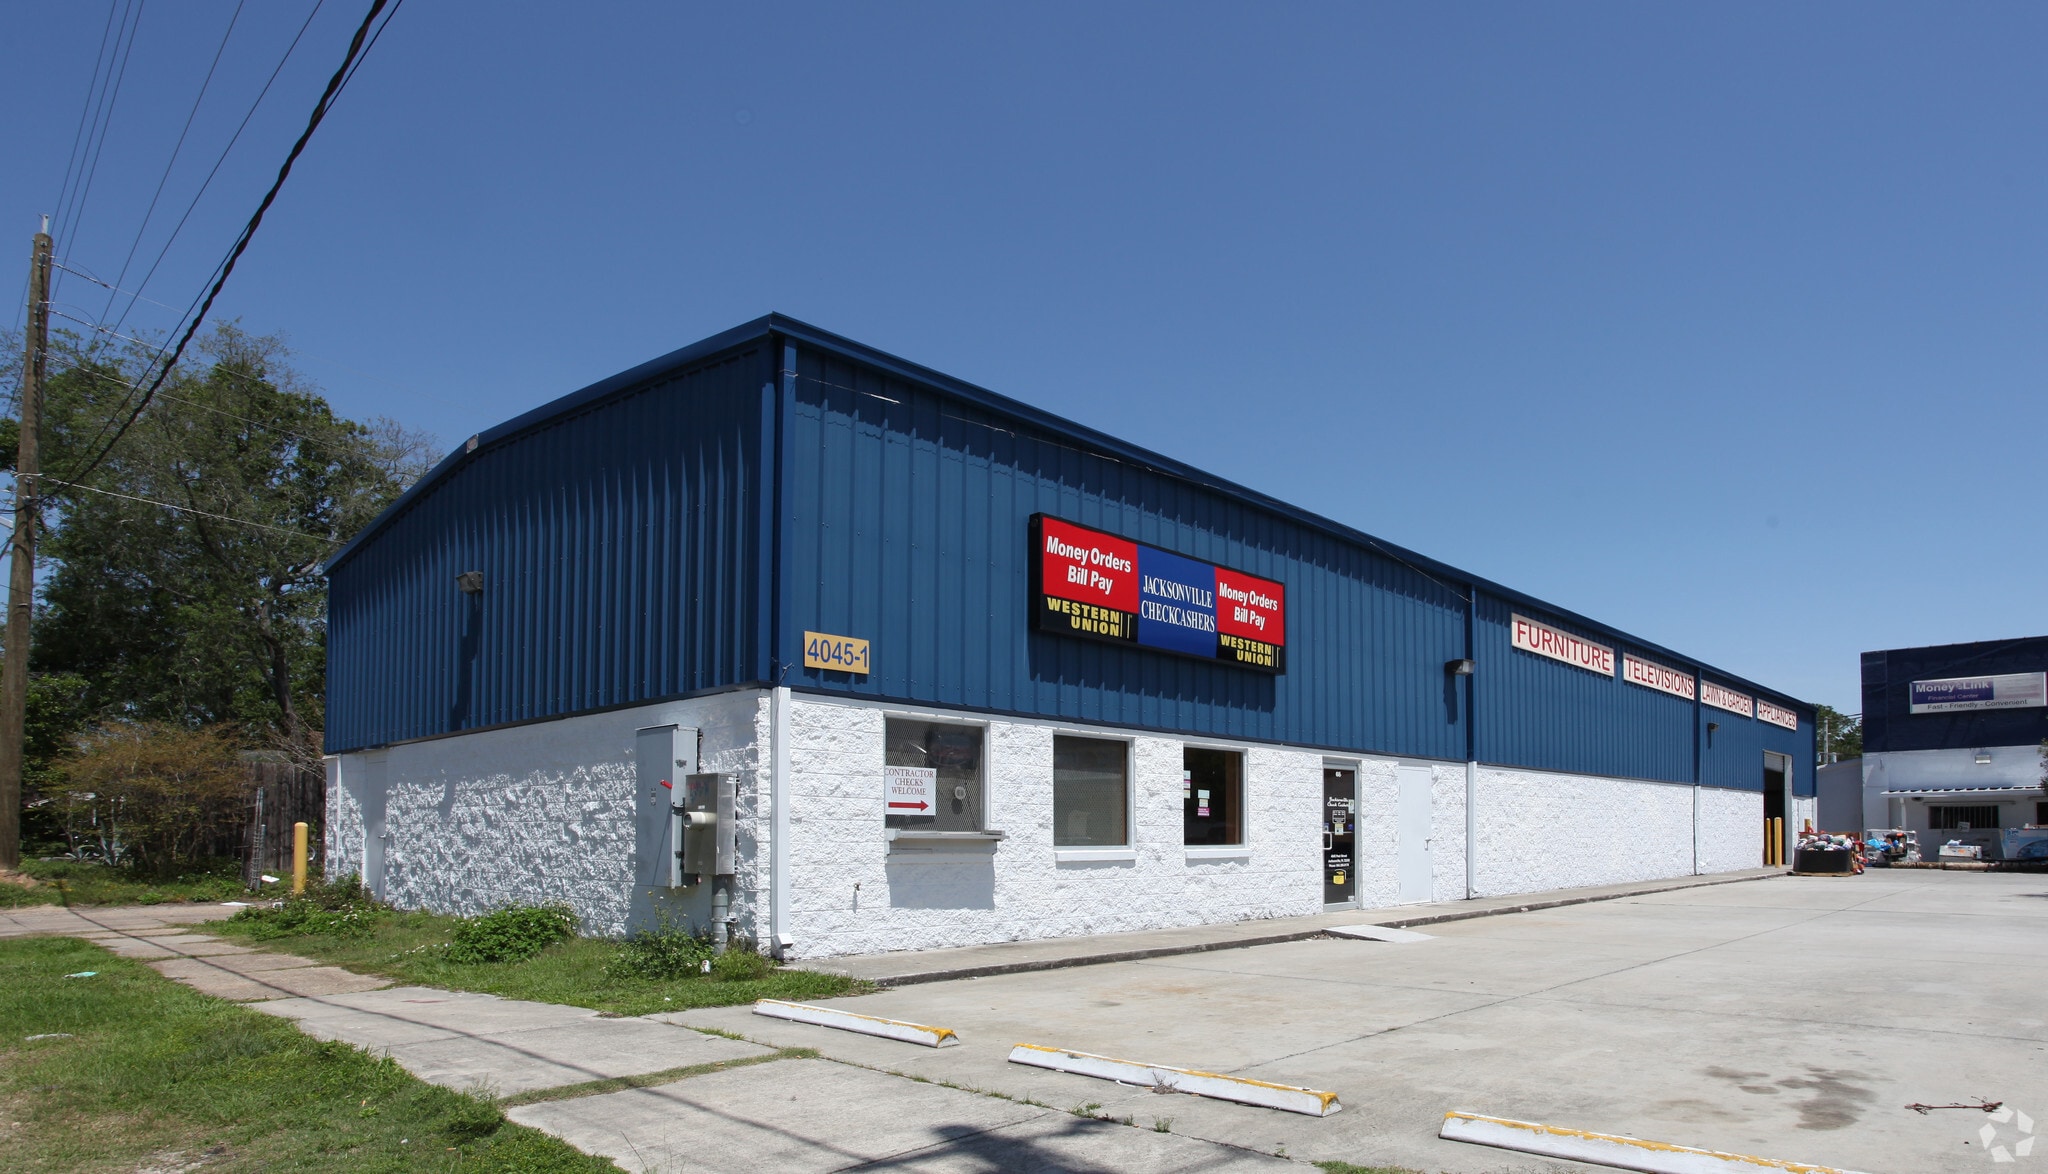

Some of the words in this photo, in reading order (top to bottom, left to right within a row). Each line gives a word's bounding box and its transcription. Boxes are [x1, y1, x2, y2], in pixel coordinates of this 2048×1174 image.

[1046, 535, 1089, 566] Money
[1090, 547, 1131, 573] Orders
[1067, 564, 1088, 586] Bill
[1090, 570, 1113, 595] Pay
[1143, 575, 1213, 609] JACKSONVILLE
[1219, 582, 1249, 607] Money
[1249, 590, 1278, 611] Orders
[1046, 597, 1120, 624] WESTERN
[1141, 600, 1215, 633] CHECKCASHERS
[1234, 606, 1248, 623] Bill
[1249, 610, 1266, 631] Pay
[1070, 615, 1120, 637] UNION
[807, 638, 867, 668] 4045-1
[1220, 634, 1272, 655] WESTERN
[1517, 620, 1610, 672] FURNITURE
[1236, 650, 1272, 667] UNION
[1626, 657, 1693, 696] TELEVISIONS
[1702, 683, 1720, 705] LAWN
[1728, 692, 1752, 713] GARDEN
[1985, 699, 2028, 707] Convenient
[1759, 702, 1796, 728] APPLIANCES
[885, 768, 934, 778] CONTRACTOR
[895, 778, 924, 787] CHECKS
[891, 787, 927, 796] WELCOME
